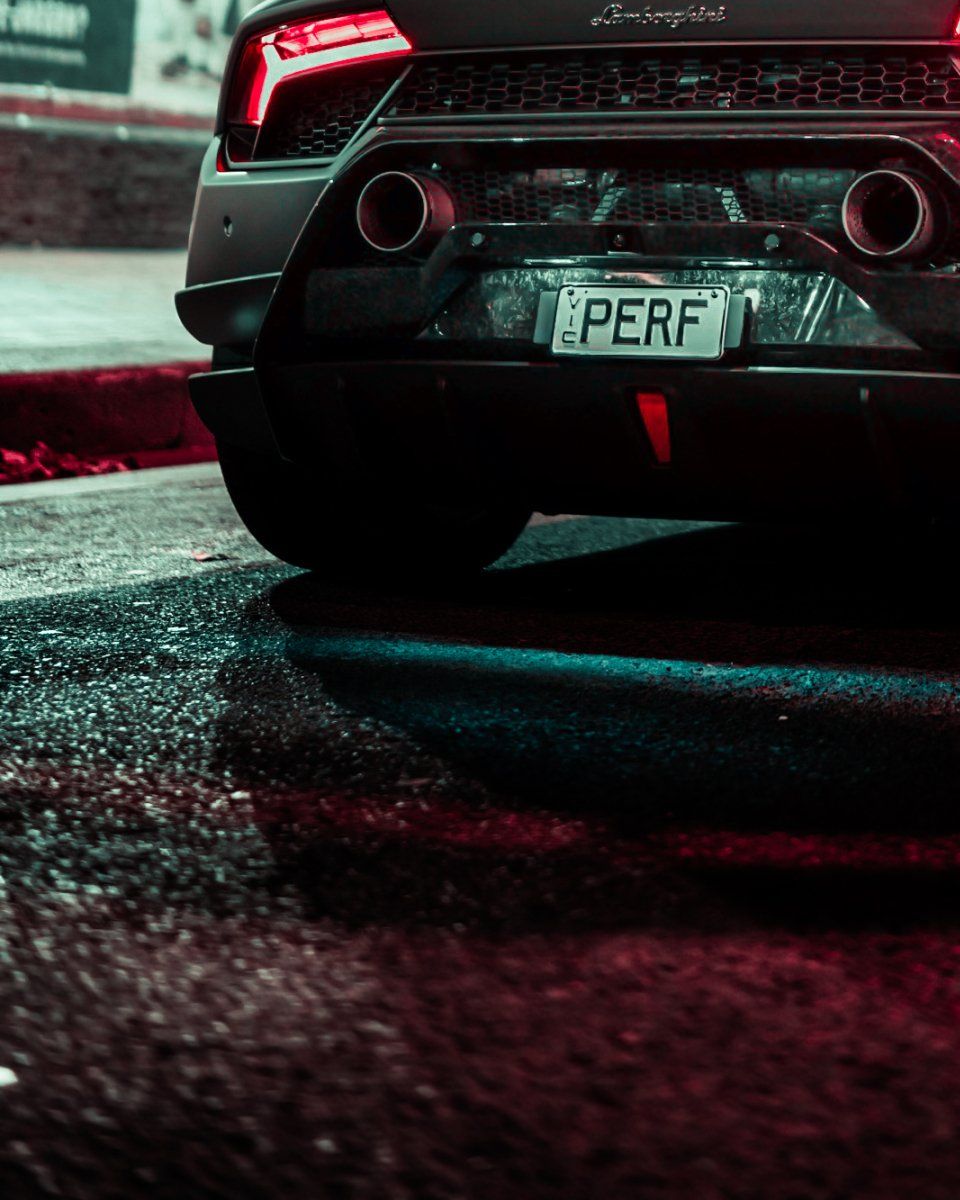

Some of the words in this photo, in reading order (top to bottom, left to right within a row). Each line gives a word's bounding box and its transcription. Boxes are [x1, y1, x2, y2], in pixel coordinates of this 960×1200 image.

[591, 3, 726, 28] Lamborghini
[561, 297, 581, 344] VIC
[579, 297, 708, 347] PERF
